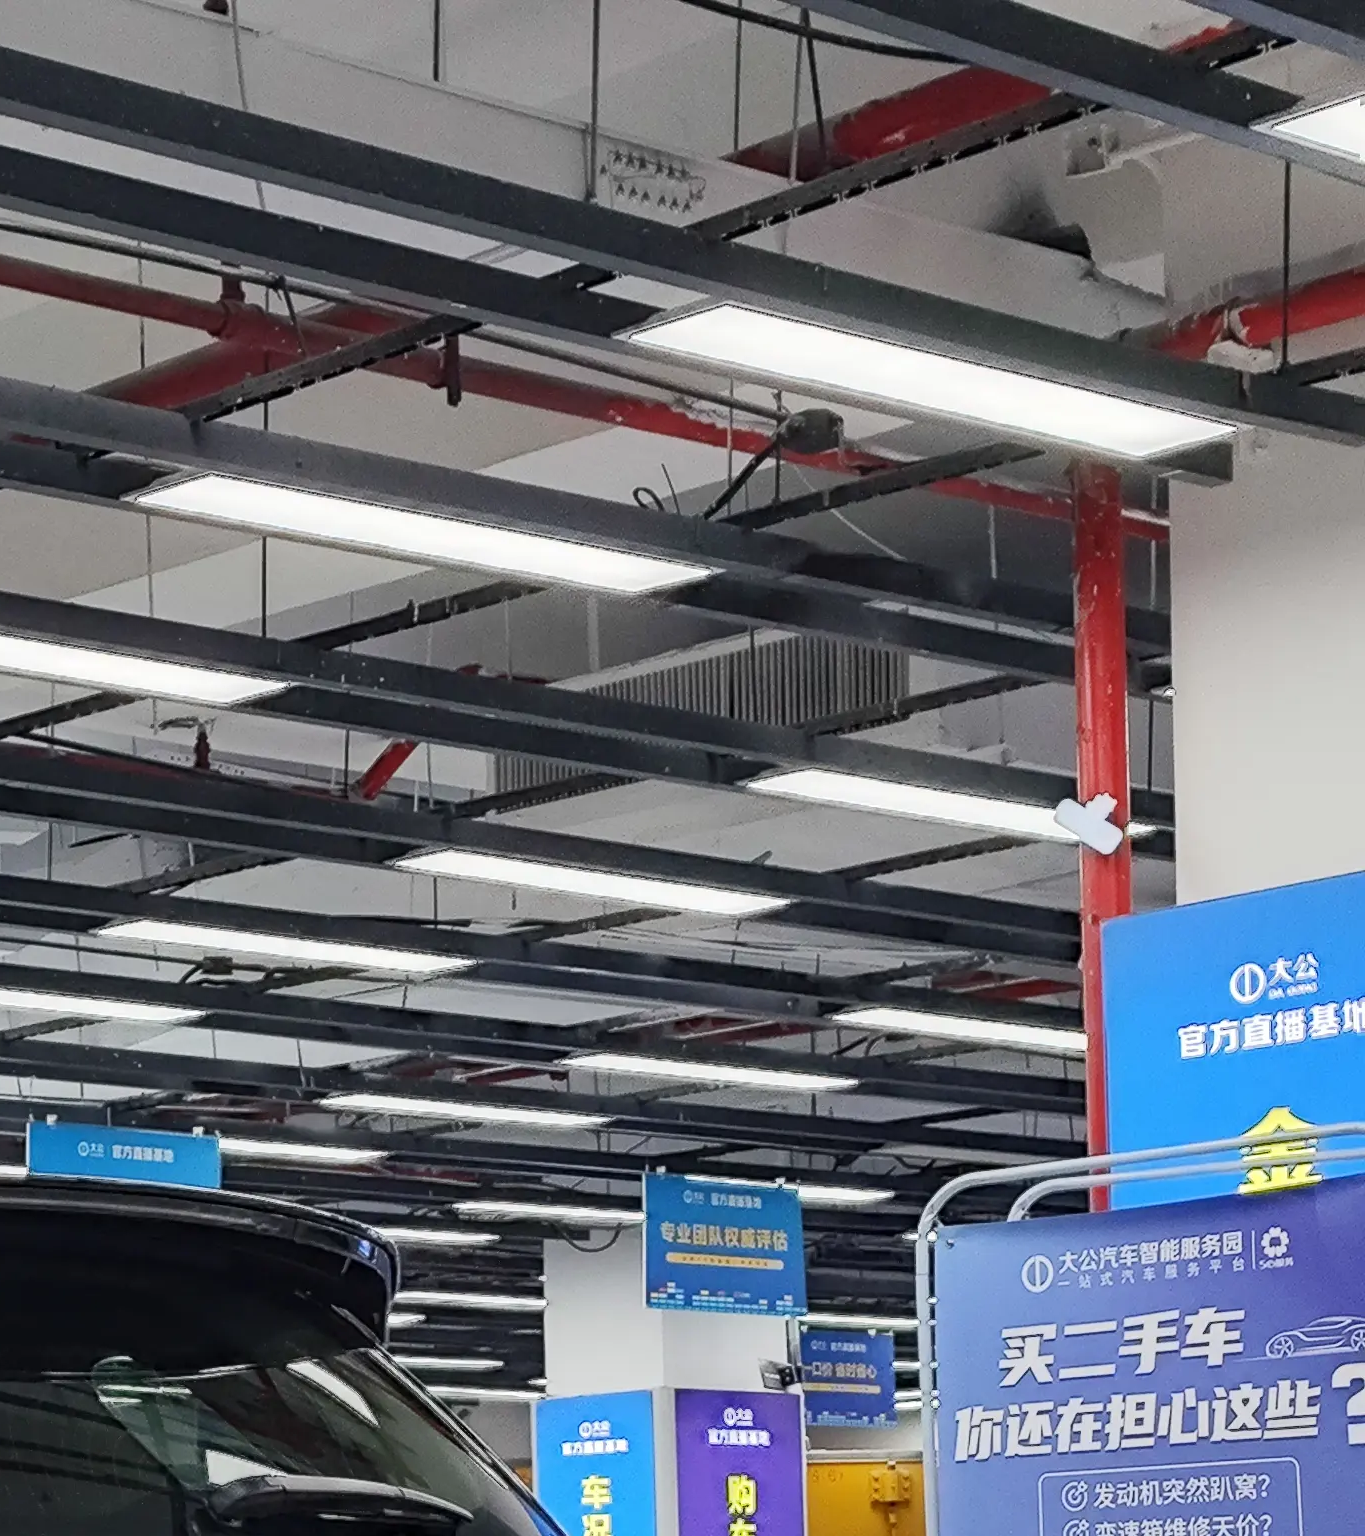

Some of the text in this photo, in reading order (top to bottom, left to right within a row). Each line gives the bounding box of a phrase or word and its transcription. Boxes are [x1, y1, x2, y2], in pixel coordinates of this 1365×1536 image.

[1269, 952, 1319, 986] 大公
[1178, 997, 1365, 1060] 官方直播基地
[660, 1221, 788, 1251] 专业团队权威评估
[1058, 1231, 1244, 1274] 大公汽车智能服务园
[1058, 1256, 1246, 1289] 一站式汽车服务平台
[999, 1306, 1245, 1388] 买二手车
[1092, 1473, 1271, 1509] 发动机突然趴窝?
